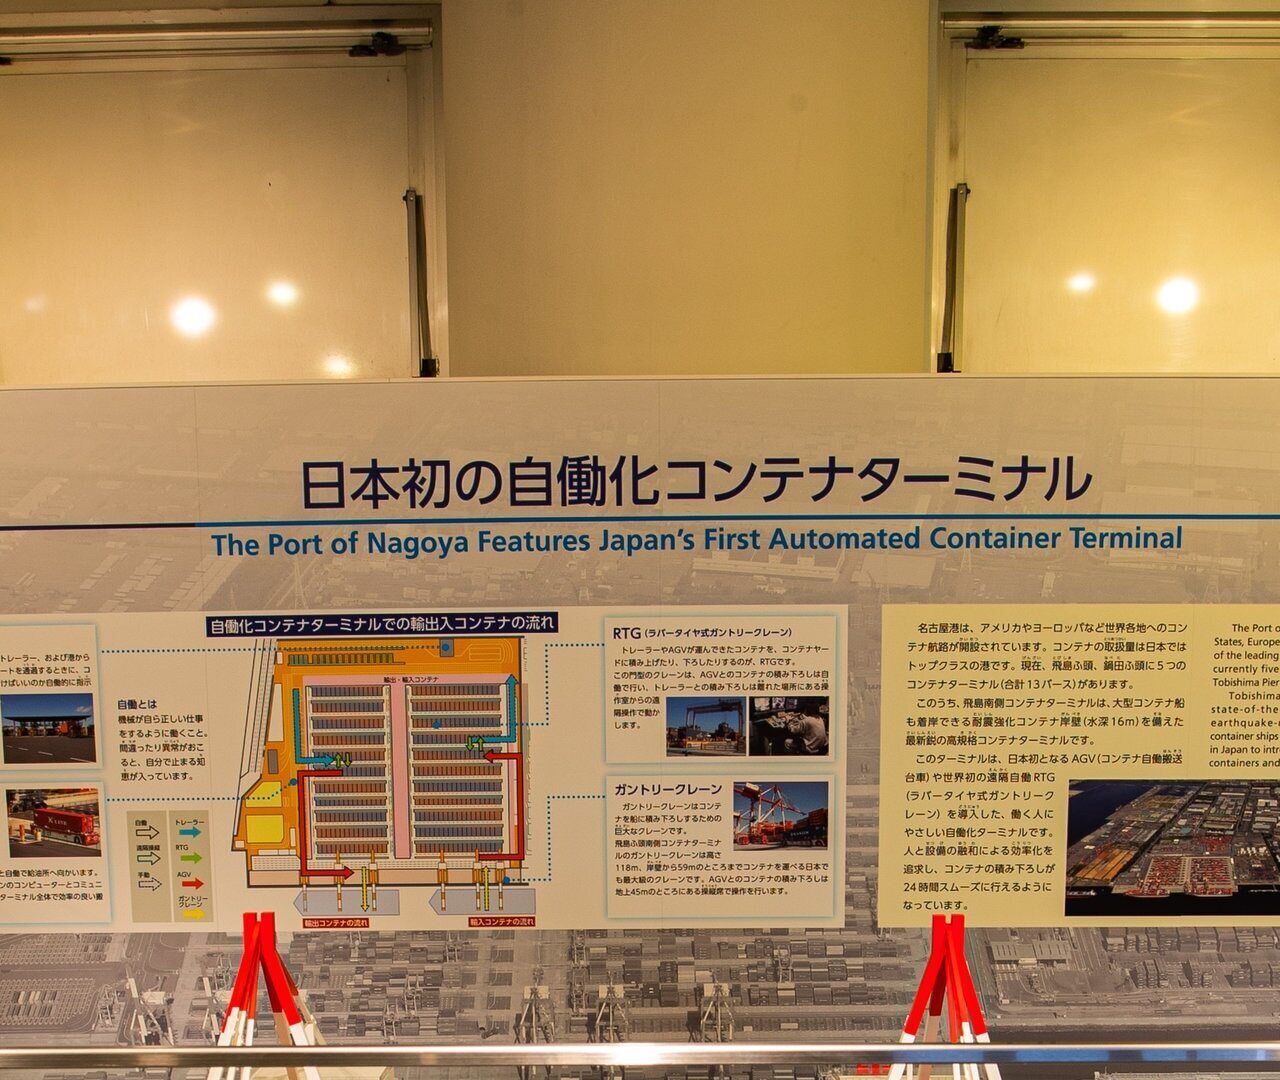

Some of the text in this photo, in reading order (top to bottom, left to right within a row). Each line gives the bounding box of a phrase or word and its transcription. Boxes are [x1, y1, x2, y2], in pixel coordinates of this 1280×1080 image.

[302, 456, 1092, 508] 日本初の自働化コンテナターミナル
[210, 526, 1182, 559] The Port of Nagoya Features Japan's First Automated Container Terminal
[211, 616, 554, 633] 自働化コンテナターミナルでの輸出入コンテナの流れ
[1231, 623, 1249, 632] The
[1252, 623, 1272, 632] Port
[613, 626, 641, 639] RTG
[117, 699, 157, 710] 自働とは
[615, 783, 722, 795] ガントリークレーン
[902, 900, 967, 910] なっています。
